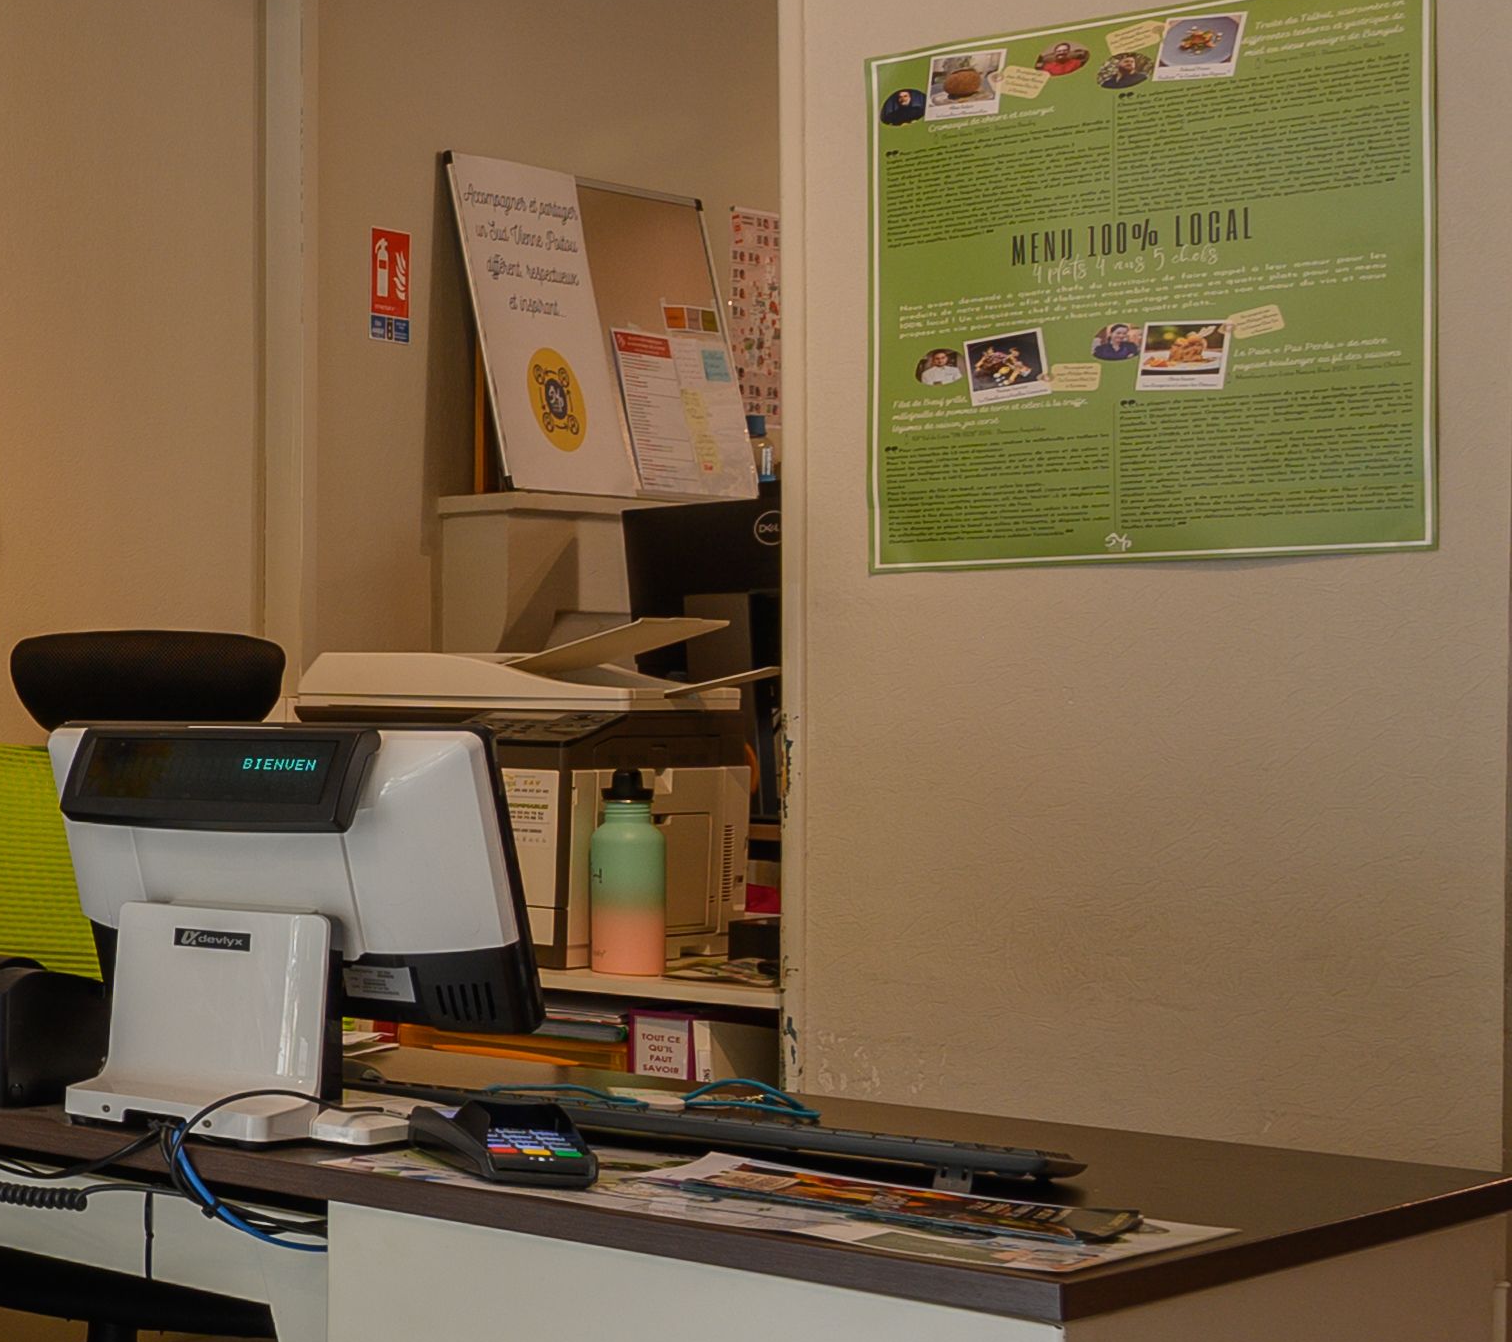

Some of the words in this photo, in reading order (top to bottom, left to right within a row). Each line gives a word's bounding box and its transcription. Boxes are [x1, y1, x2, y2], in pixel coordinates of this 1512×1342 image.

[1011, 228, 1073, 266] MENU
[1087, 218, 1158, 258] 100%
[1175, 207, 1252, 248] LOCAL
[242, 757, 317, 772] BIENVEN
[198, 932, 244, 948] devlyx
[642, 1033, 665, 1041] TOUT
[648, 1044, 673, 1053] QU'IL
[643, 1064, 679, 1073] SAVOIR
